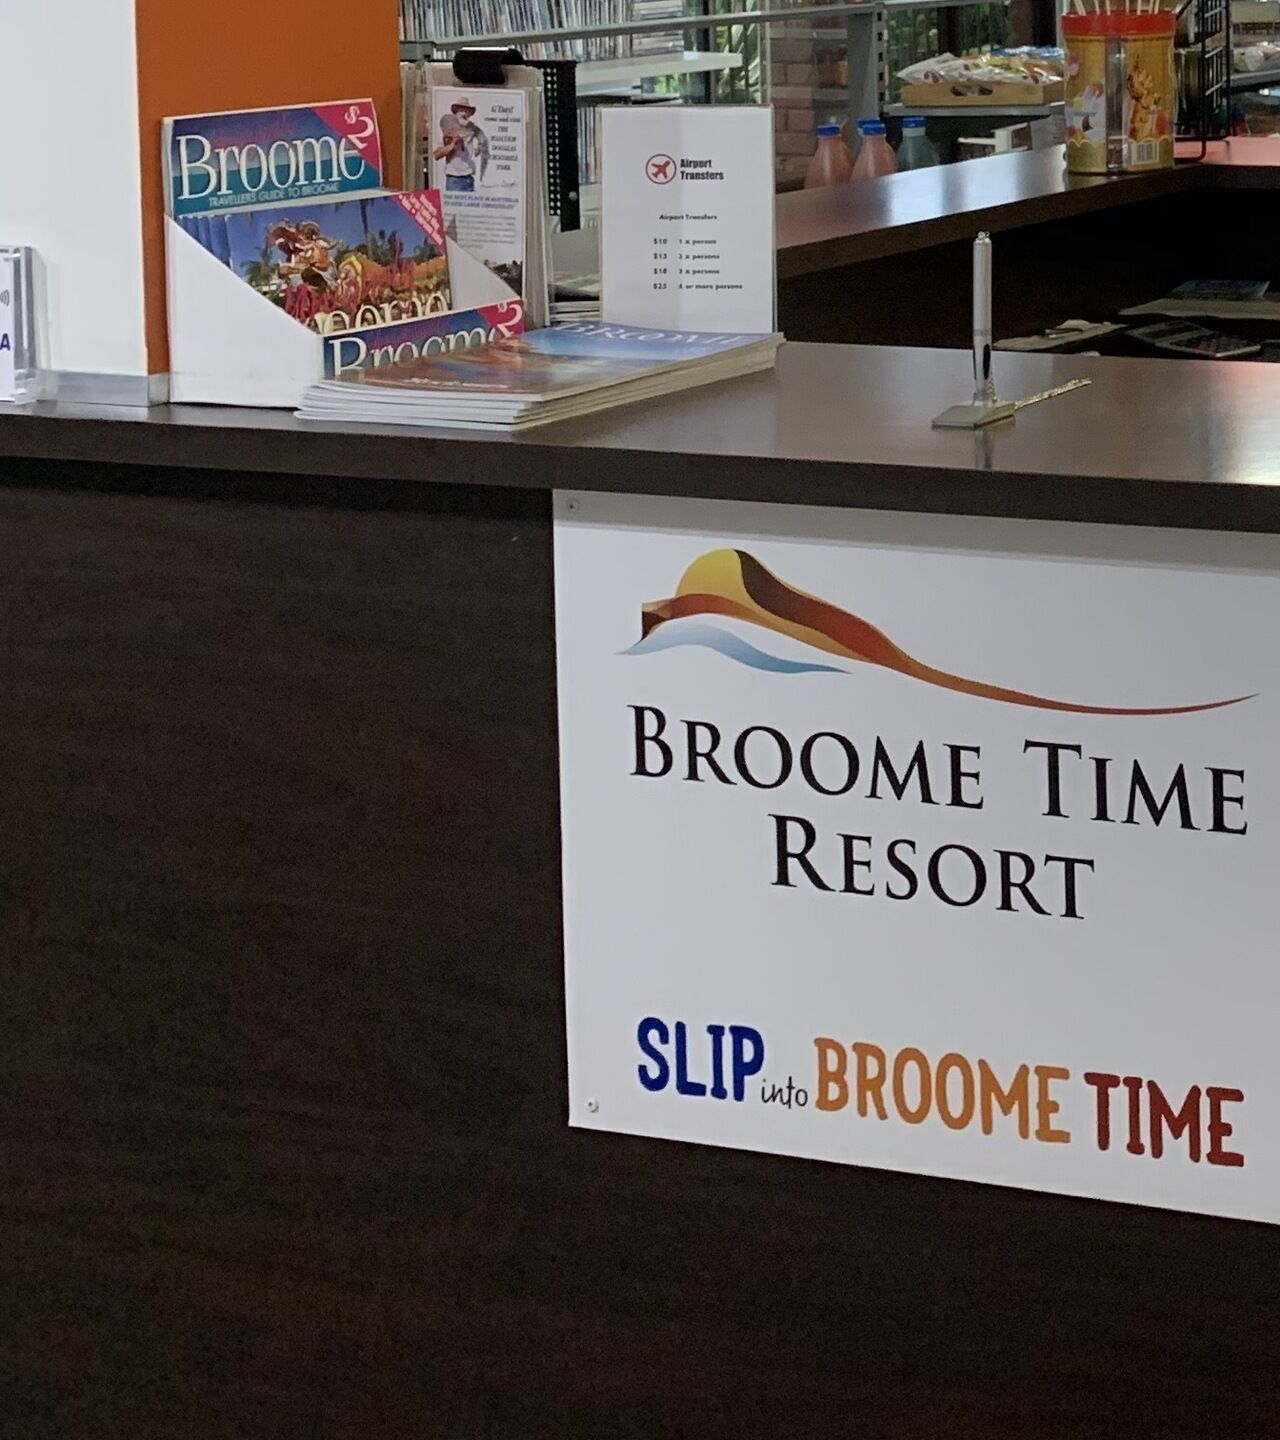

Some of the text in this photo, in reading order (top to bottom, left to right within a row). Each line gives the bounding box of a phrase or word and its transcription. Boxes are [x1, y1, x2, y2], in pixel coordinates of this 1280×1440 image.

[176, 134, 366, 200] Broome
[680, 159, 712, 170] Airport
[680, 171, 724, 180] Transfers
[627, 704, 1248, 836] BROOME TIME
[767, 813, 1095, 920] RESORT
[637, 1017, 1245, 1168] SLIP into BROOME TIME
